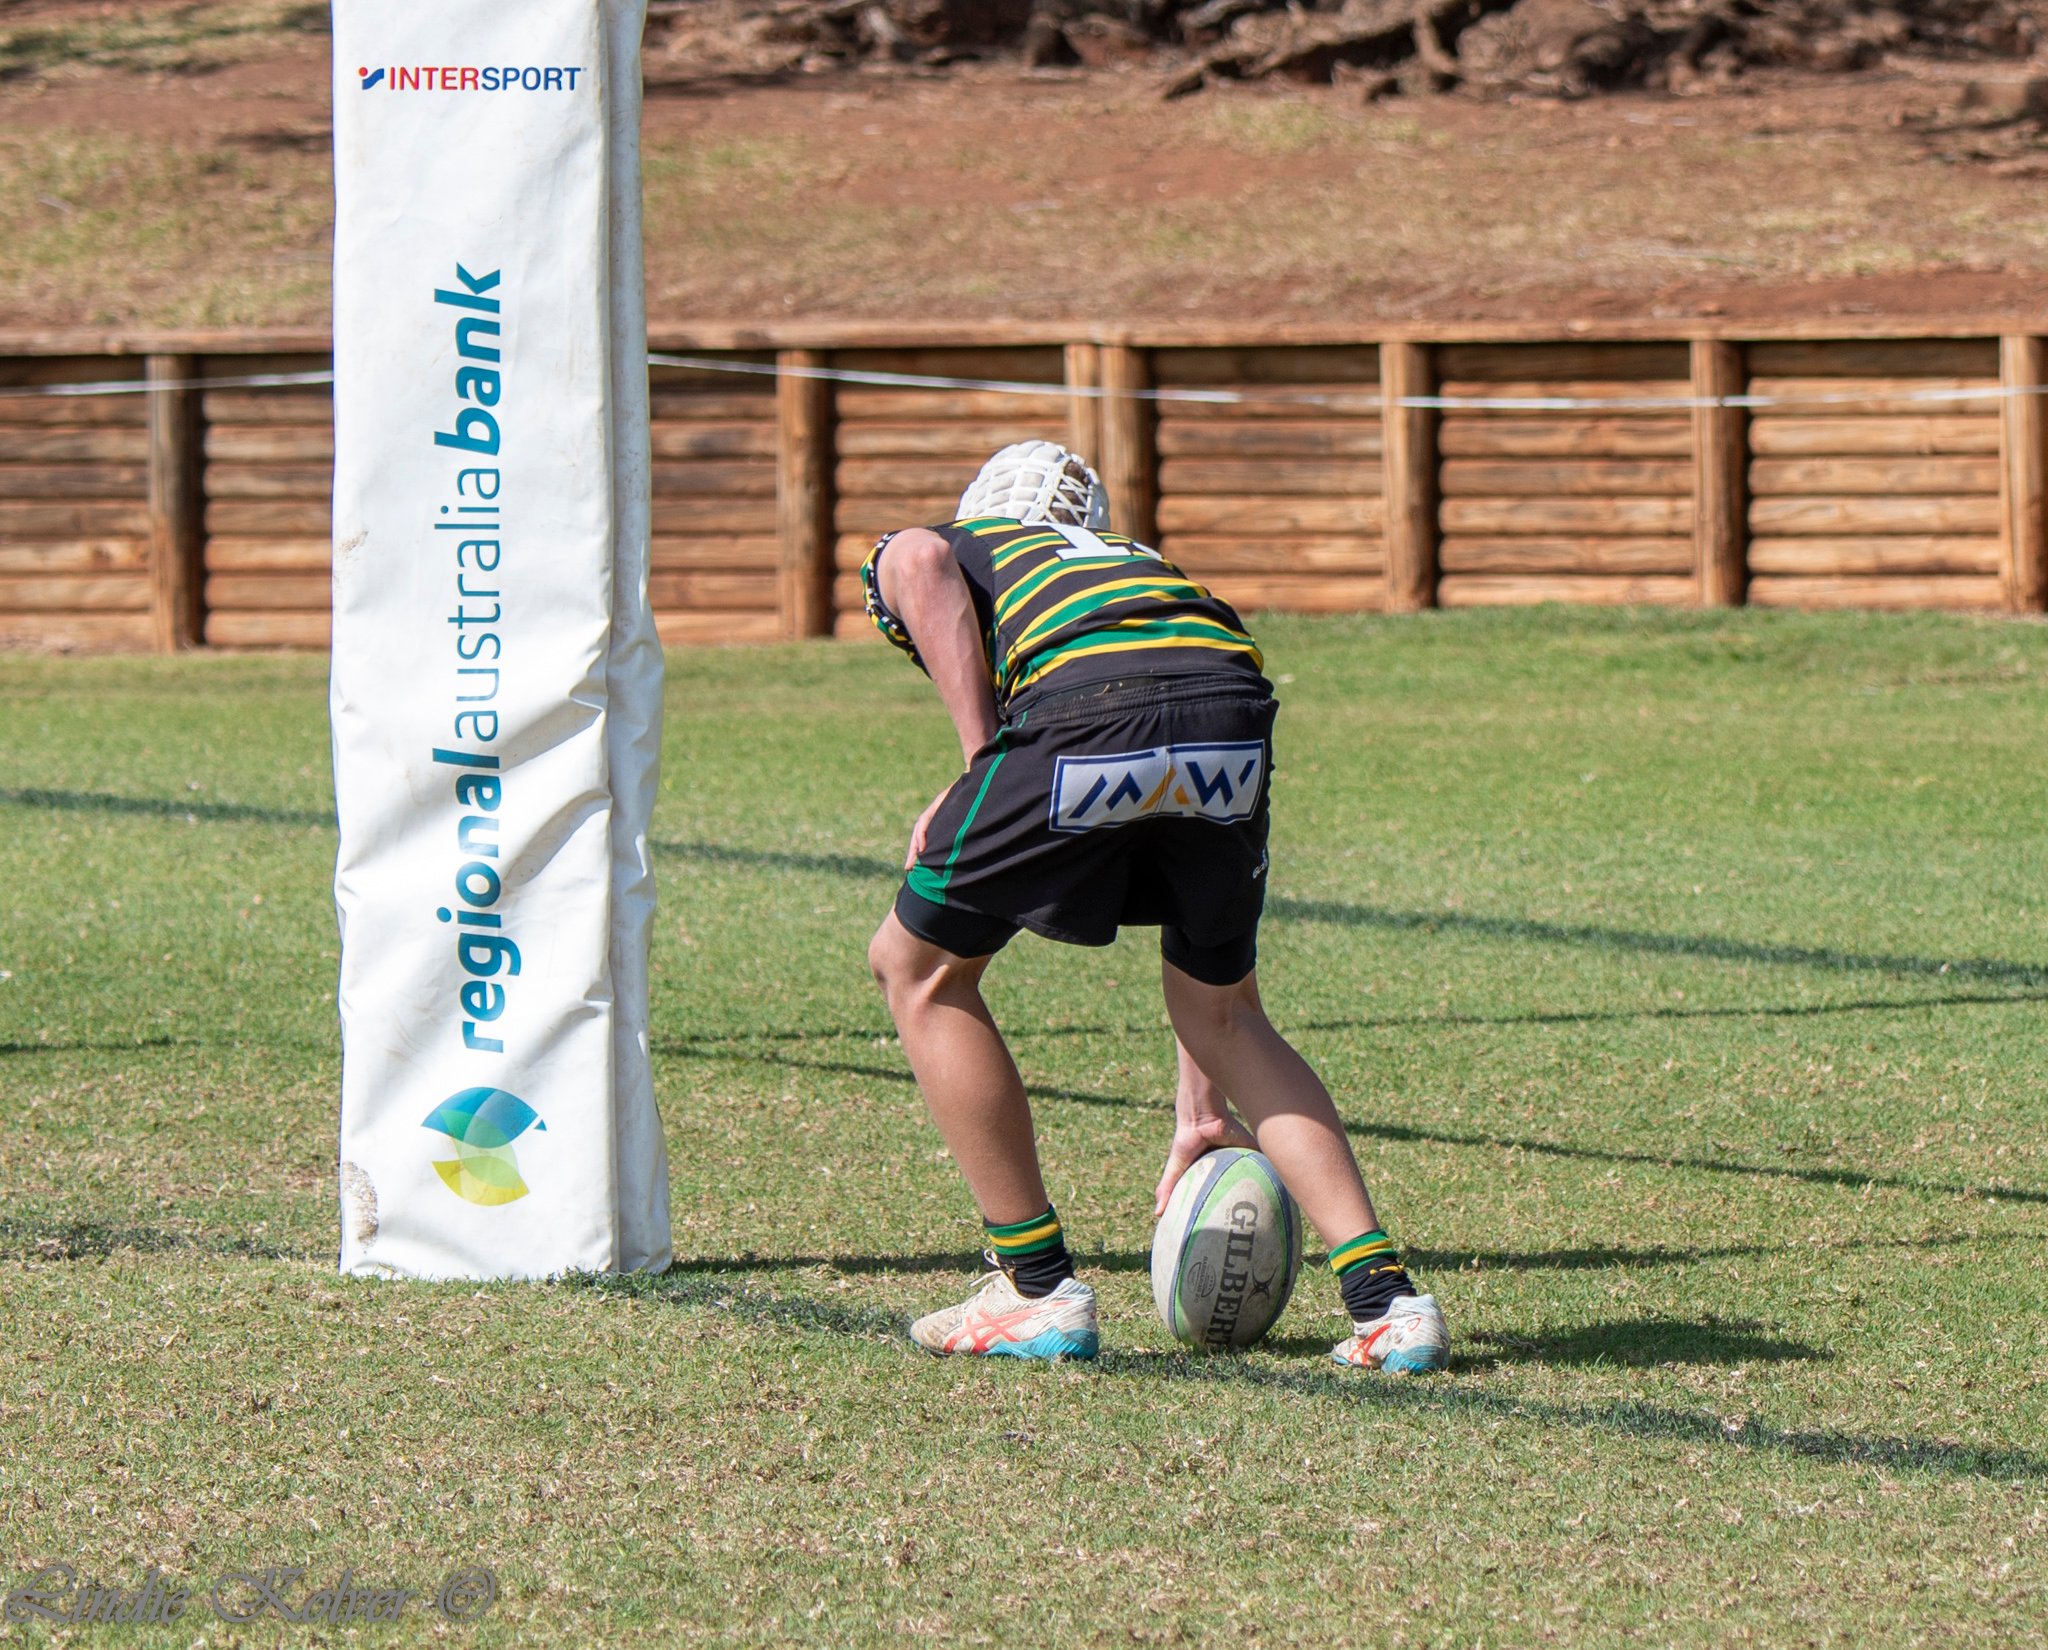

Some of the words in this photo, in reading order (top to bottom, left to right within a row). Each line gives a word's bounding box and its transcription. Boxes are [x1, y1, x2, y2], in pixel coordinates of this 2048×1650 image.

[389, 66, 582, 92] INTERSPORT
[1020, 518, 1163, 561] 1
[1204, 1200, 1259, 1346] GILBERT
